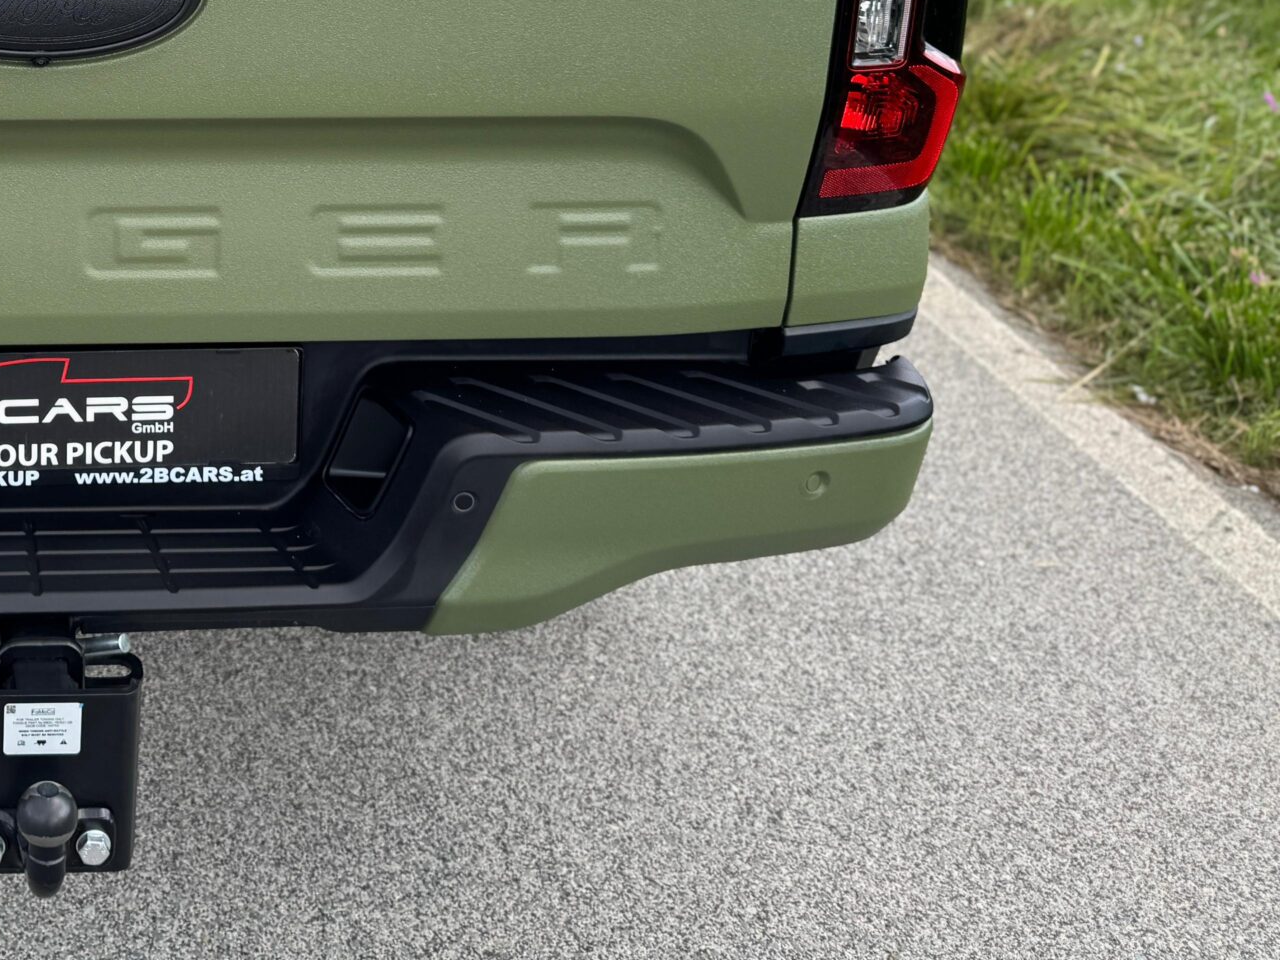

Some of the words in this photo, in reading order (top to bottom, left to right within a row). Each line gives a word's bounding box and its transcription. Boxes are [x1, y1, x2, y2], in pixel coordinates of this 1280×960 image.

[131, 422, 174, 434] GmbH
[66, 439, 174, 465] PICKUP
[74, 466, 264, 484] www.2BCARS.at
